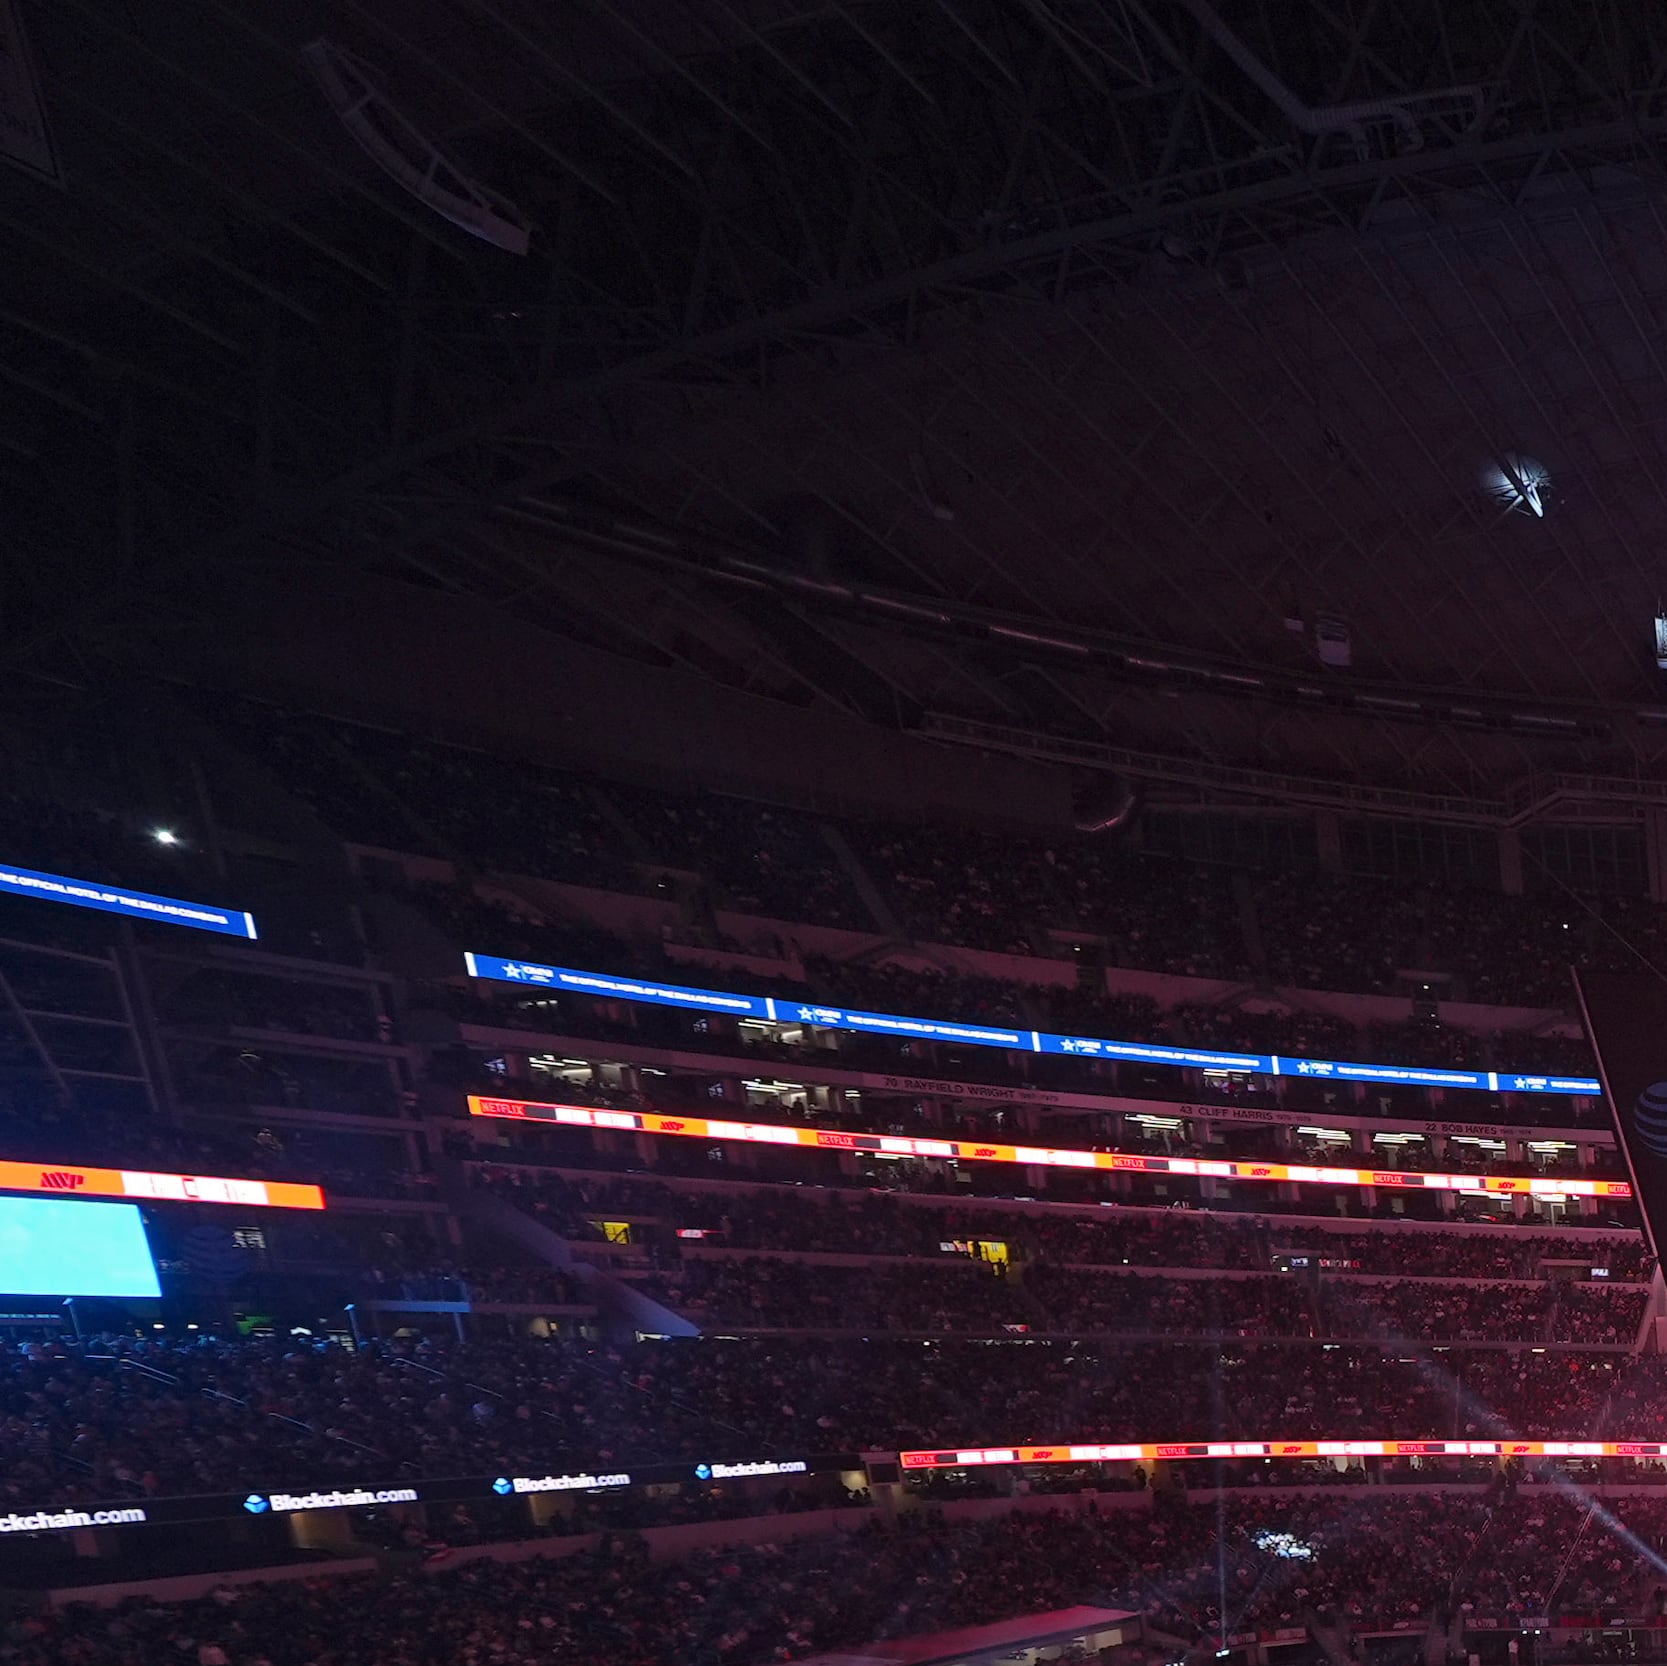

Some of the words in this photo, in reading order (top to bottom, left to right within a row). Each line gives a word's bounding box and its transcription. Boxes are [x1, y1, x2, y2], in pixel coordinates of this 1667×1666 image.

[885, 1078, 898, 1088] 70
[904, 1080, 964, 1094] RAYFIELD
[968, 1086, 1014, 1099] WRIGHT
[481, 1102, 524, 1116] NETFLIX
[1180, 1106, 1192, 1114] 43
[1198, 1107, 1228, 1118] CLIFF
[1233, 1110, 1273, 1120] HARRIS
[1426, 1123, 1436, 1132] 22
[1442, 1124, 1463, 1133] BOB
[1466, 1126, 1497, 1135] HAYES
[818, 1134, 854, 1146] NETFLIX
[1112, 1156, 1145, 1168] NETFLIX
[1374, 1174, 1402, 1184] NETFLIX
[1158, 1446, 1187, 1455] NETFLIX
[1398, 1444, 1424, 1452] NETFLIX
[905, 1454, 937, 1464] NETFLIX
[712, 1460, 806, 1480] Blockchain.com
[513, 1472, 630, 1494] Blockchain.com
[270, 1486, 418, 1512] Blockchain.com
